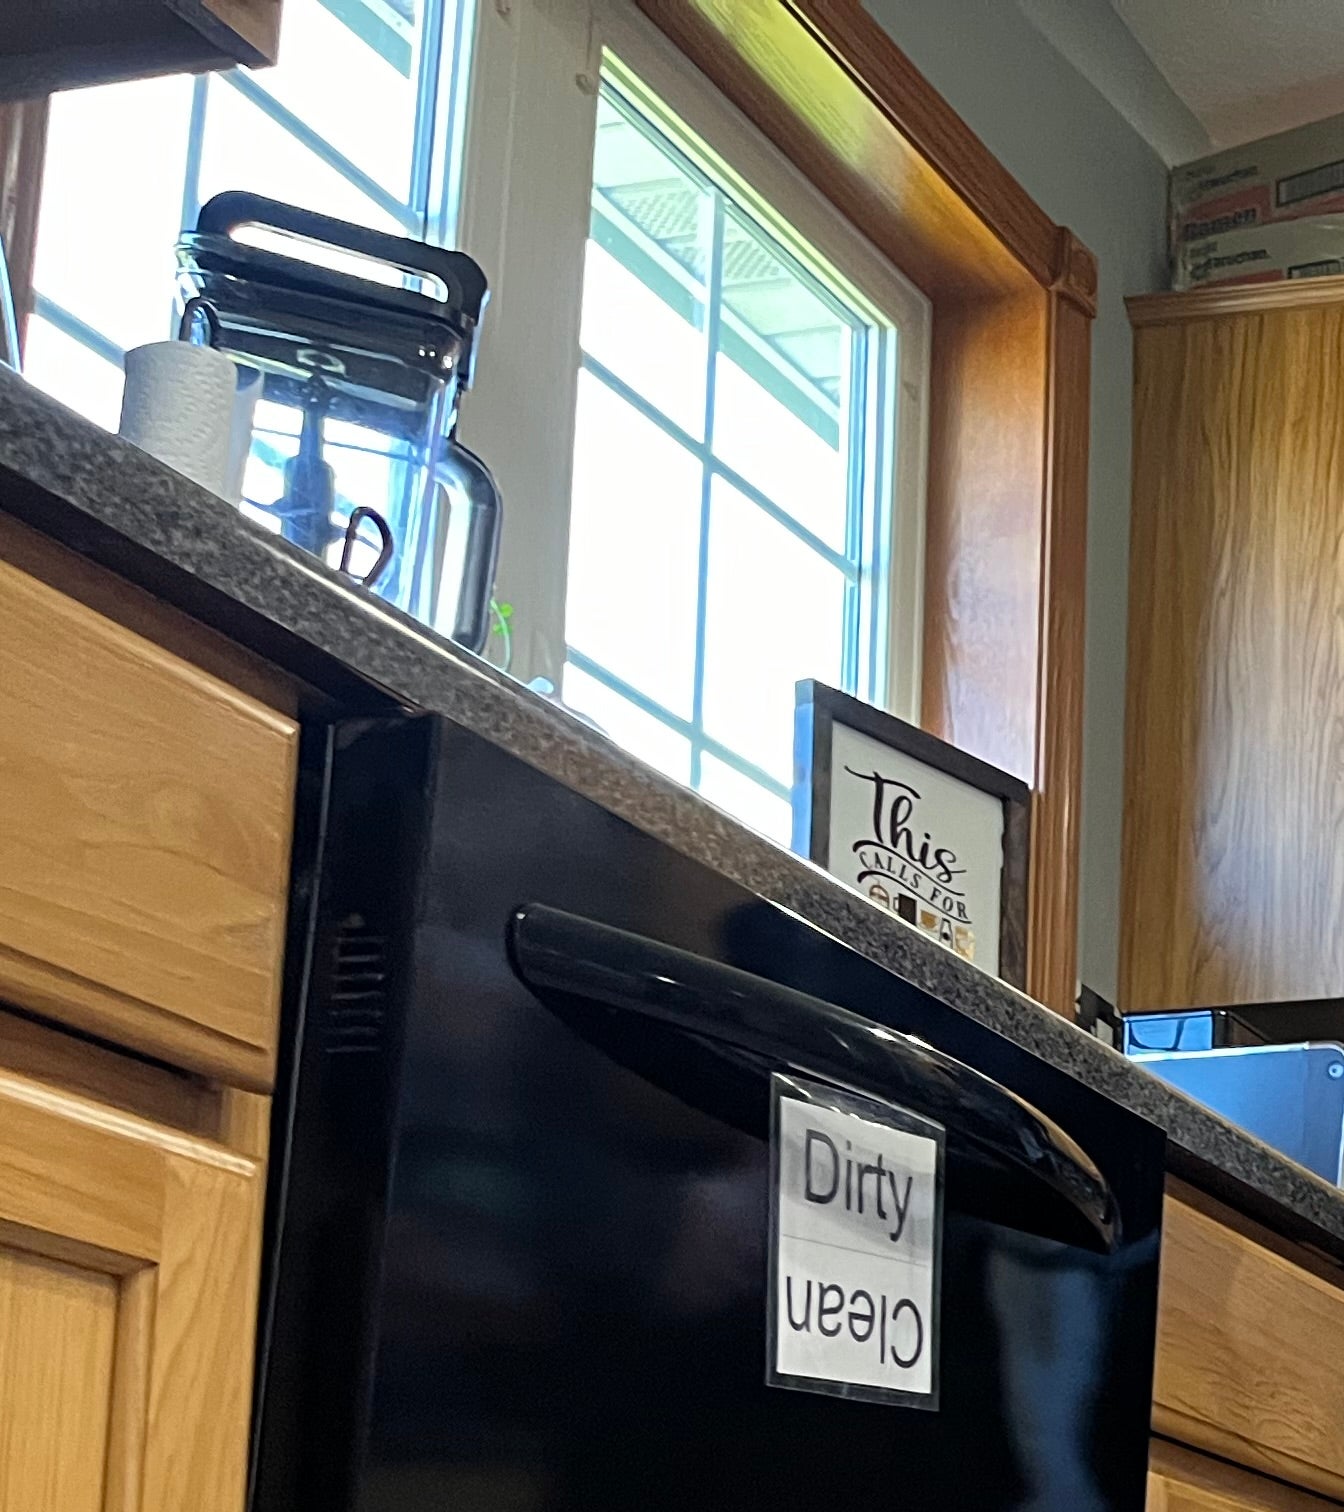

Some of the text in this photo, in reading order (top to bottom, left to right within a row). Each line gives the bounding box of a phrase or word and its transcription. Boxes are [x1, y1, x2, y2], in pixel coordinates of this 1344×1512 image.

[844, 765, 967, 884] This
[859, 850, 969, 920] CALLS FOR
[804, 1128, 913, 1243] Dirty
[786, 1276, 923, 1369] Clean
